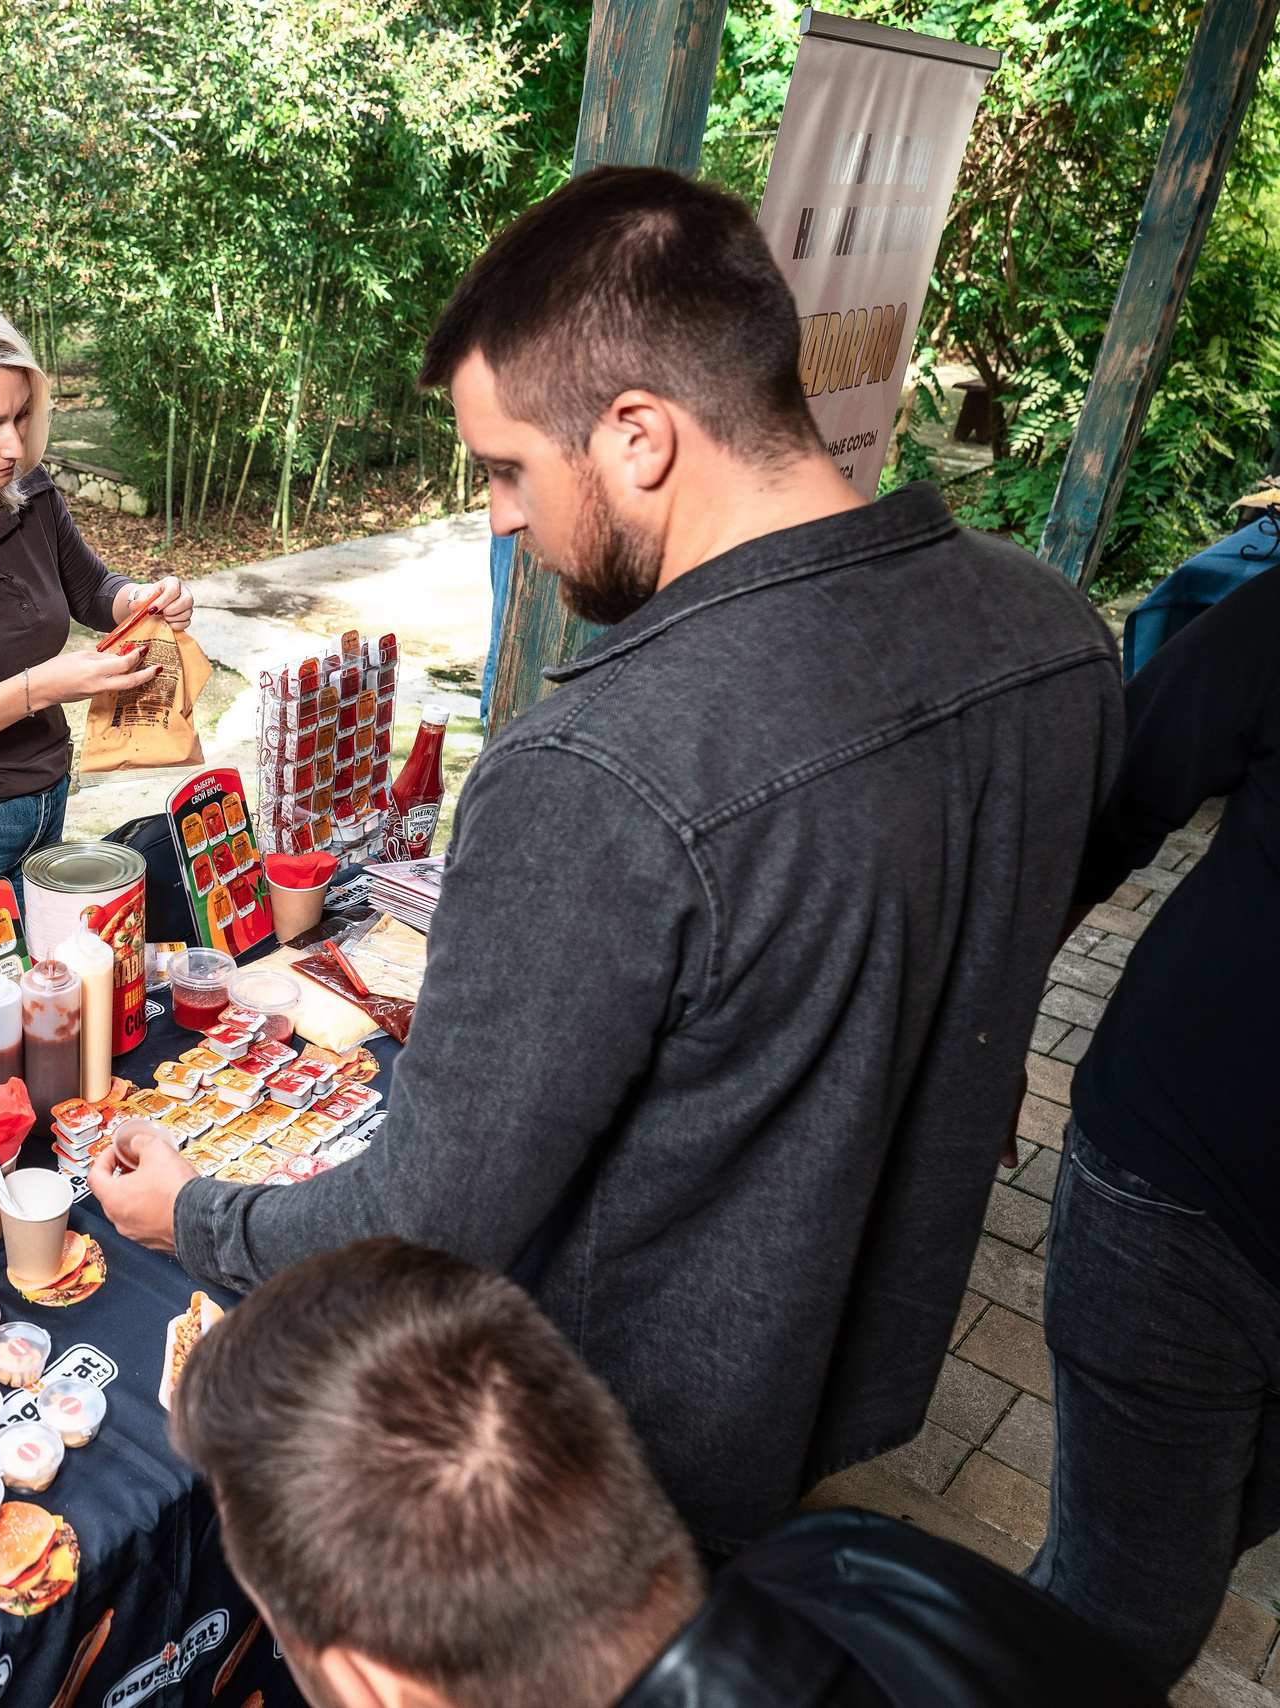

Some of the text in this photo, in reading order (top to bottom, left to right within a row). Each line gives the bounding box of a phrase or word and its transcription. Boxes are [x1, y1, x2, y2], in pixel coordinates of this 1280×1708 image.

[793, 207, 822, 259] НА
[847, 429, 878, 455] СОУСЫ
[191, 790, 208, 805] СВОЙ
[206, 782, 222, 798] ВКУС!
[193, 775, 215, 793] ВЫБЕРИ
[415, 809, 435, 818] HEINZ
[324, 877, 373, 908] agerst
[1, 961, 13, 970] HEINZ
[112, 1621, 219, 1707] bagertat
[154, 1637, 217, 1686] FOOERVICE
